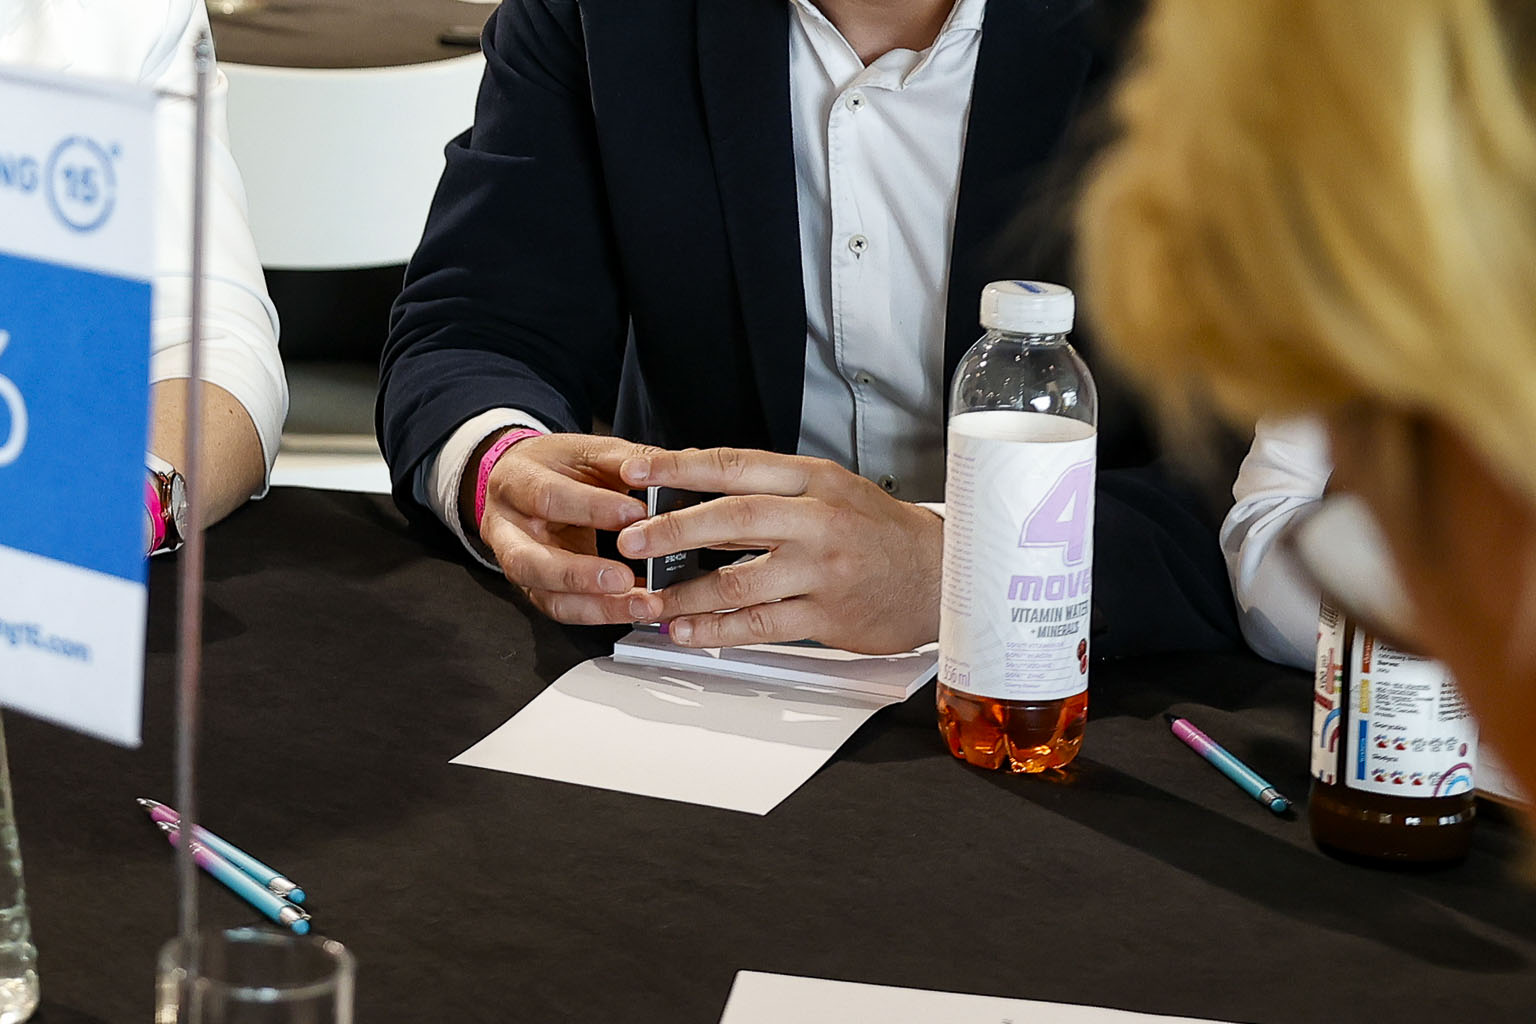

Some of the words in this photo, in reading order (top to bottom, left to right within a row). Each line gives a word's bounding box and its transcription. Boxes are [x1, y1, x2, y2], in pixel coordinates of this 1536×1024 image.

[63, 166, 99, 203] 15
[1018, 458, 1093, 567] 4
[1011, 606, 1063, 624] VITAMIN
